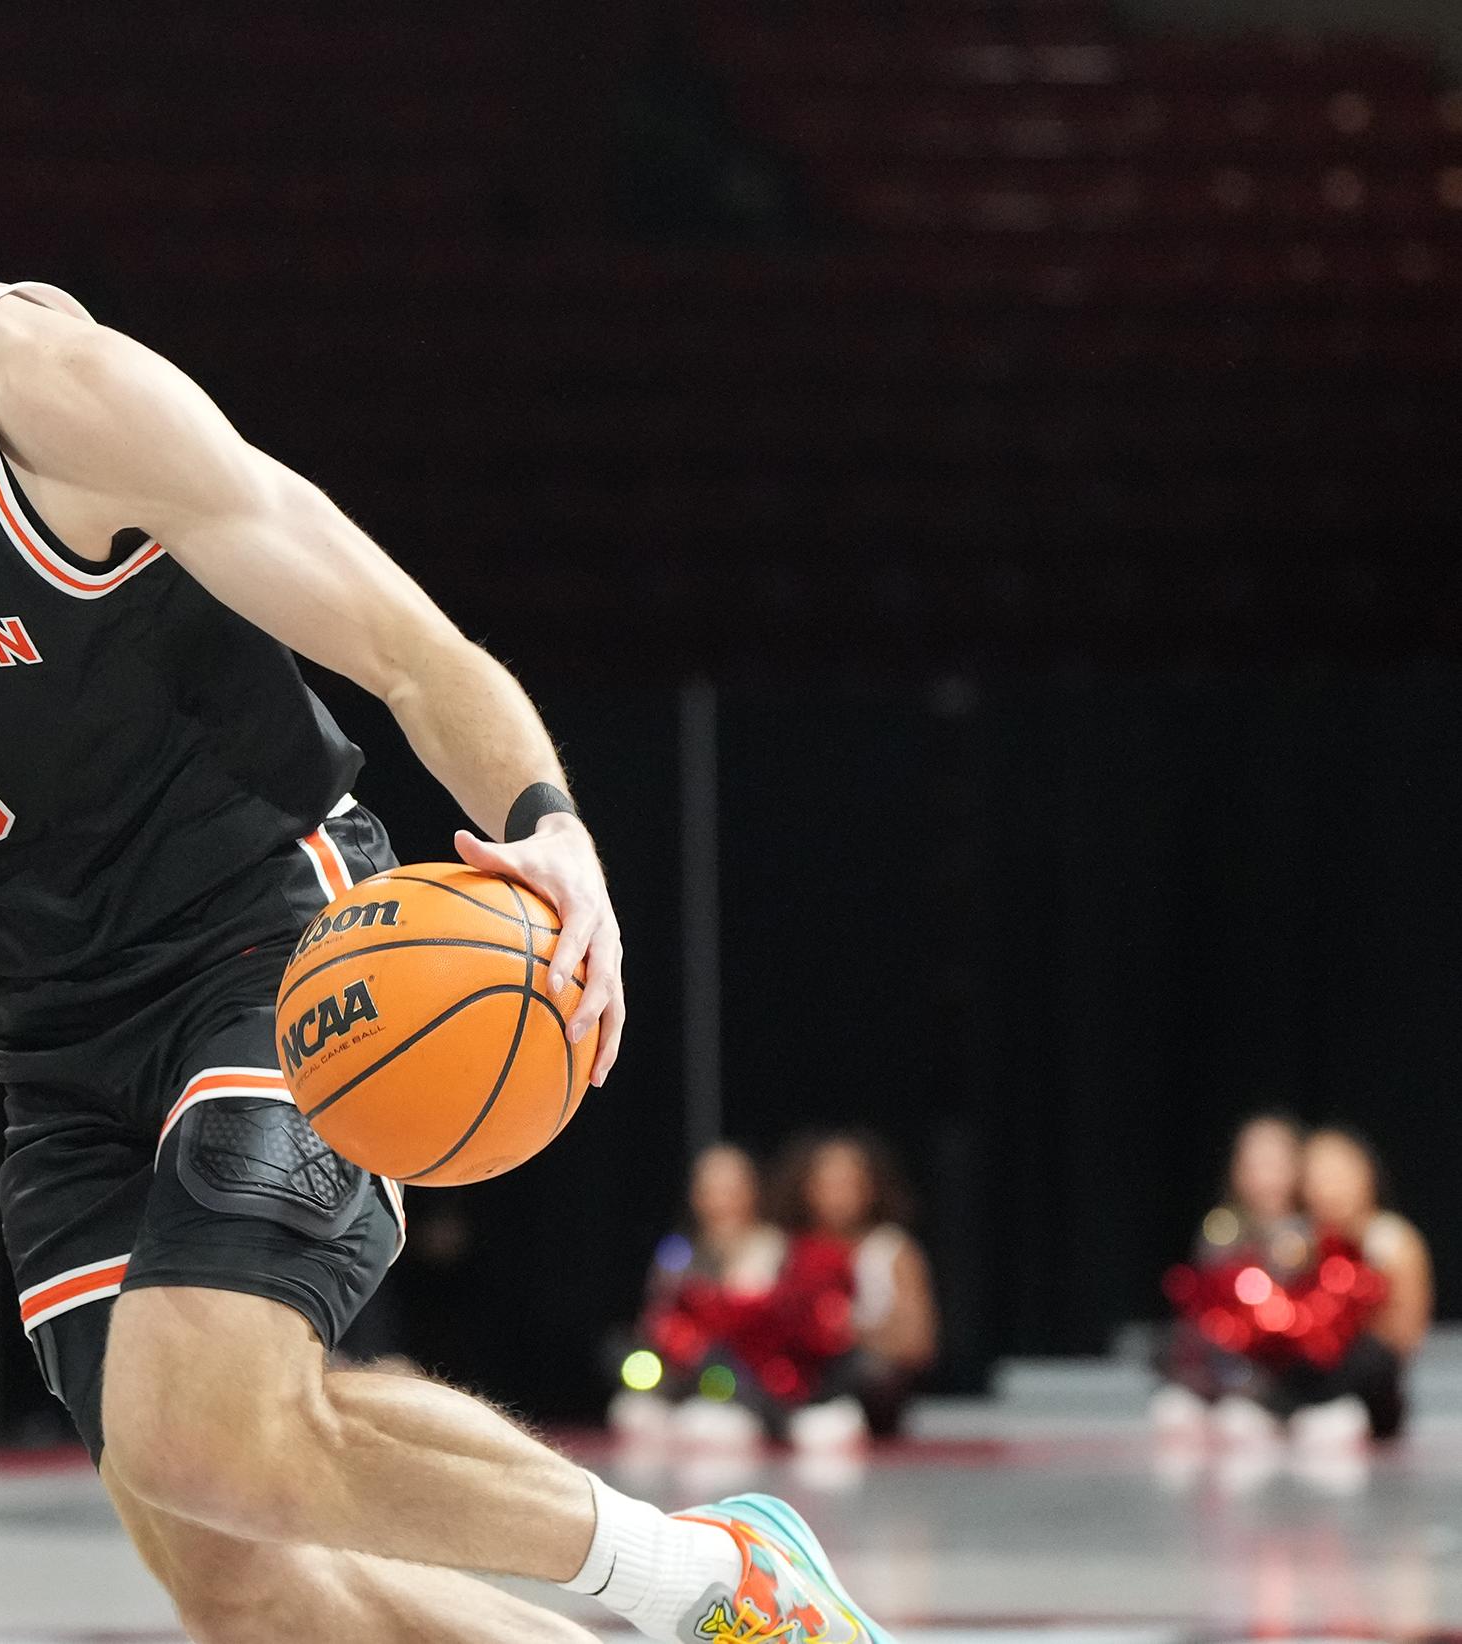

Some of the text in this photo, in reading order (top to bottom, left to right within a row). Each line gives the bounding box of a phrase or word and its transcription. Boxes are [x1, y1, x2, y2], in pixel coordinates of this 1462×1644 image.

[281, 978, 379, 1078] NCAA
[320, 1041, 350, 1065] GAME
[352, 1023, 386, 1045] BALL
